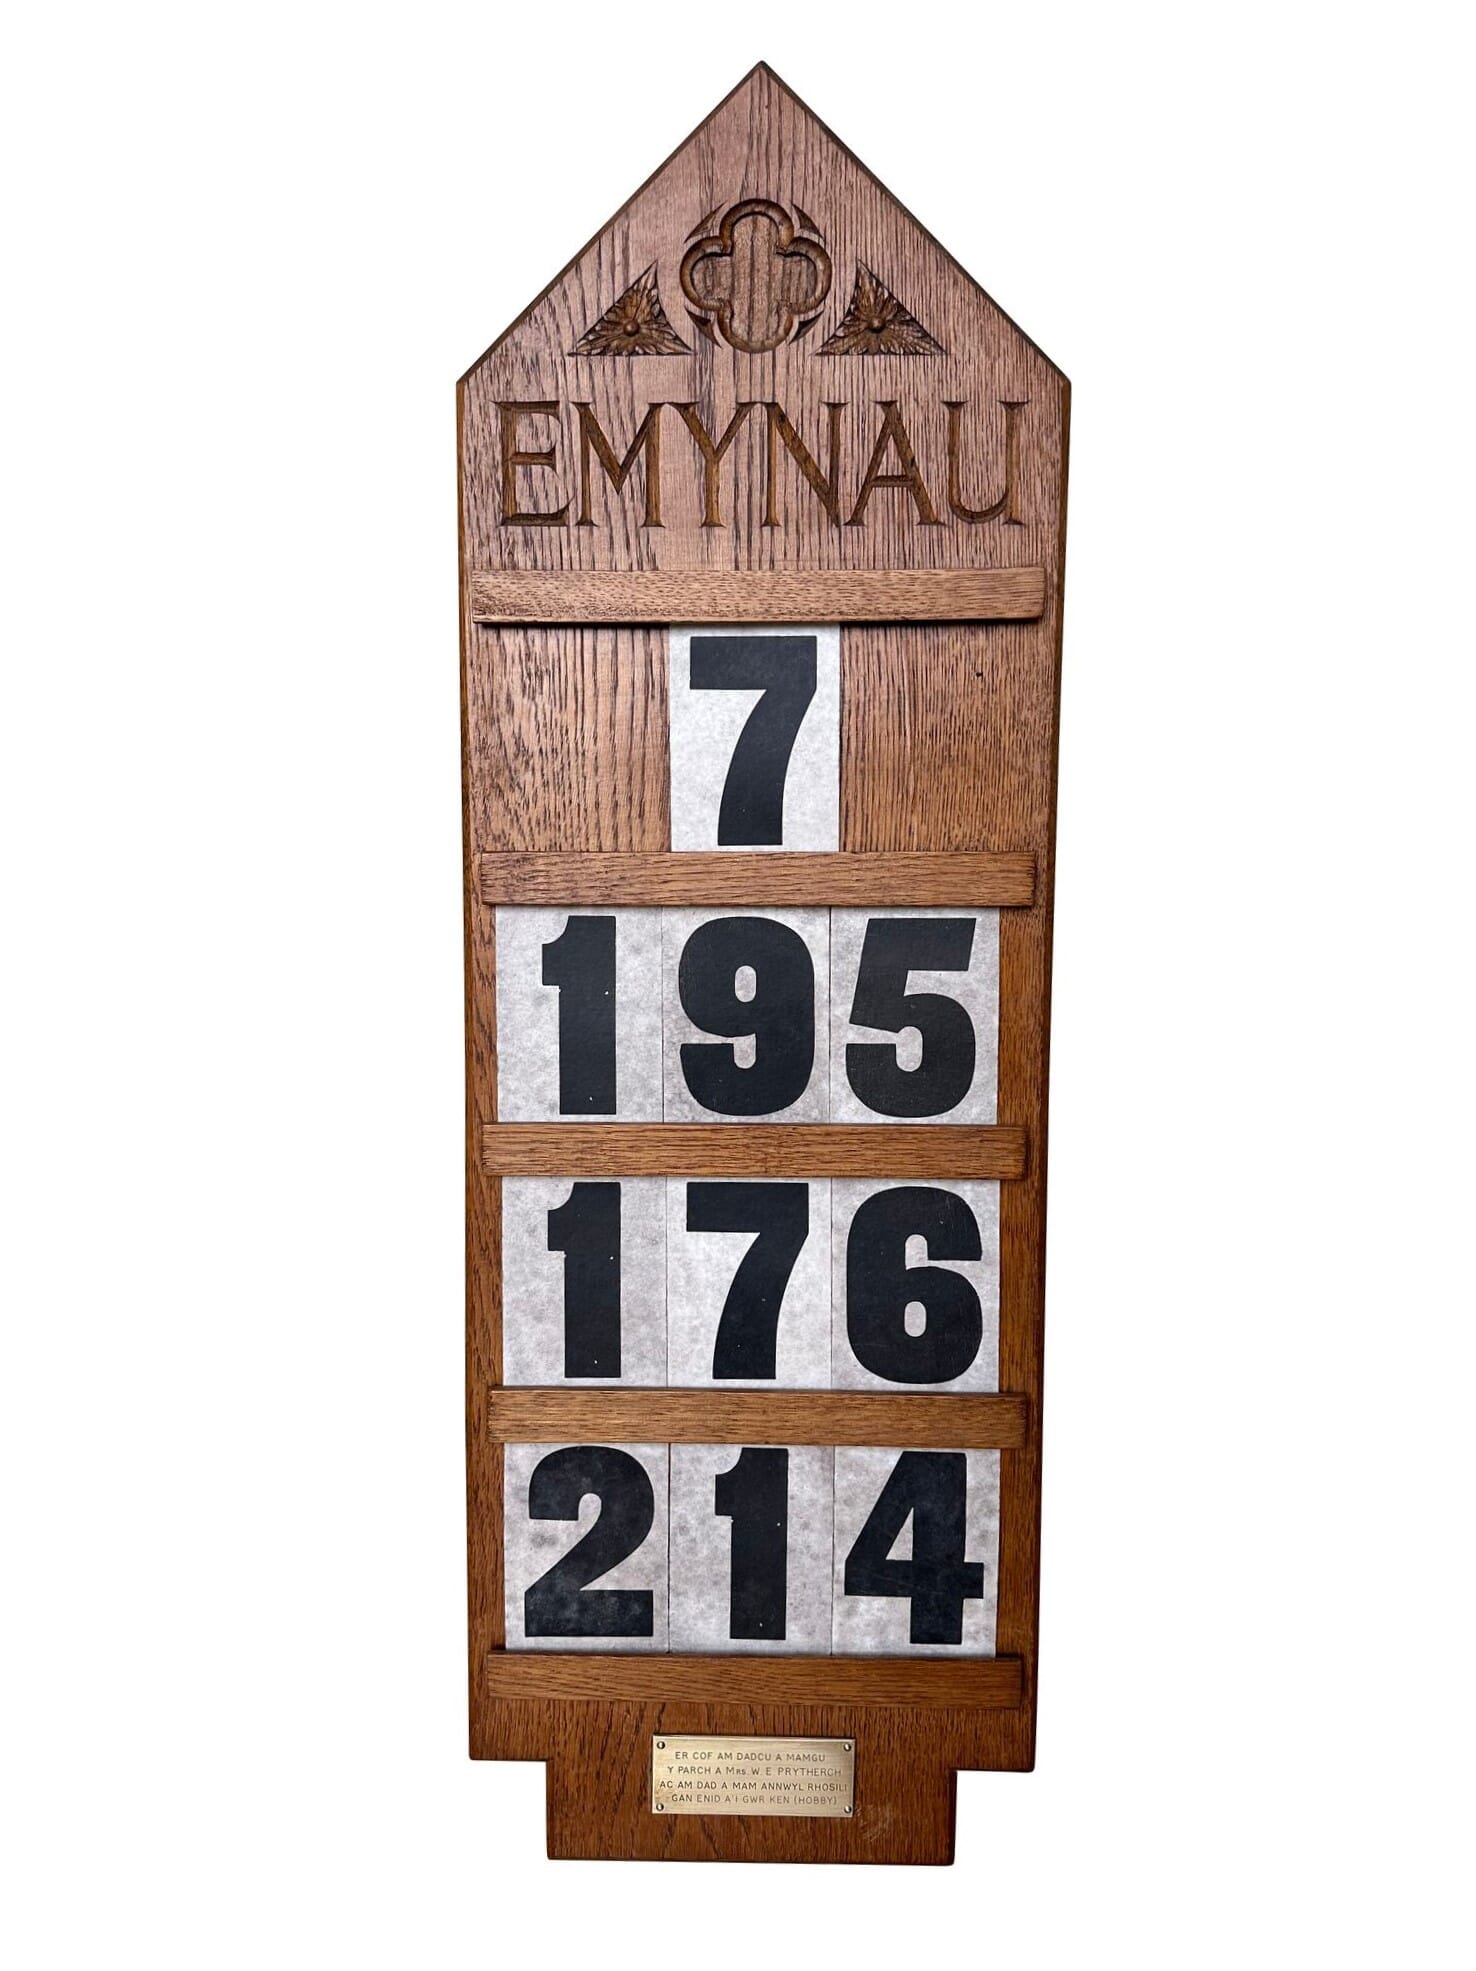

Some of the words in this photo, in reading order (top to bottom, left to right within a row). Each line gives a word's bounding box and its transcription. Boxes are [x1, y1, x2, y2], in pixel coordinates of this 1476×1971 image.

[497, 399, 1029, 528] EMYNAU
[690, 636, 817, 846] 7
[542, 916, 976, 1118] 195
[548, 1182, 982, 1384] 176
[525, 1446, 984, 1645] 214
[659, 1781, 673, 1789] AC
[677, 1781, 692, 1789] AM
[697, 1781, 716, 1790] DAD
[721, 1782, 728, 1790] A
[732, 1782, 757, 1790] MAM
[761, 1782, 804, 1791] ANNWYL
[807, 1783, 847, 1792] RHOSILI
[667, 1766, 673, 1774] Y
[678, 1766, 711, 1775] PARCH
[715, 1767, 722, 1775] A
[778, 1768, 841, 1777] PRYTHERCH
[671, 1794, 692, 1802] GAN
[697, 1794, 721, 1803] ENID
[725, 1794, 738, 1803] A'I
[742, 1795, 765, 1804] GWR
[769, 1795, 790, 1804] KEN
[794, 1795, 837, 1805] (HOBBY)
[675, 1751, 688, 1760] ER
[692, 1752, 712, 1760] COF
[717, 1753, 733, 1761] AM
[737, 1753, 771, 1761] DADCU
[776, 1753, 782, 1761] A
[786, 1753, 825, 1762] MAMGU
